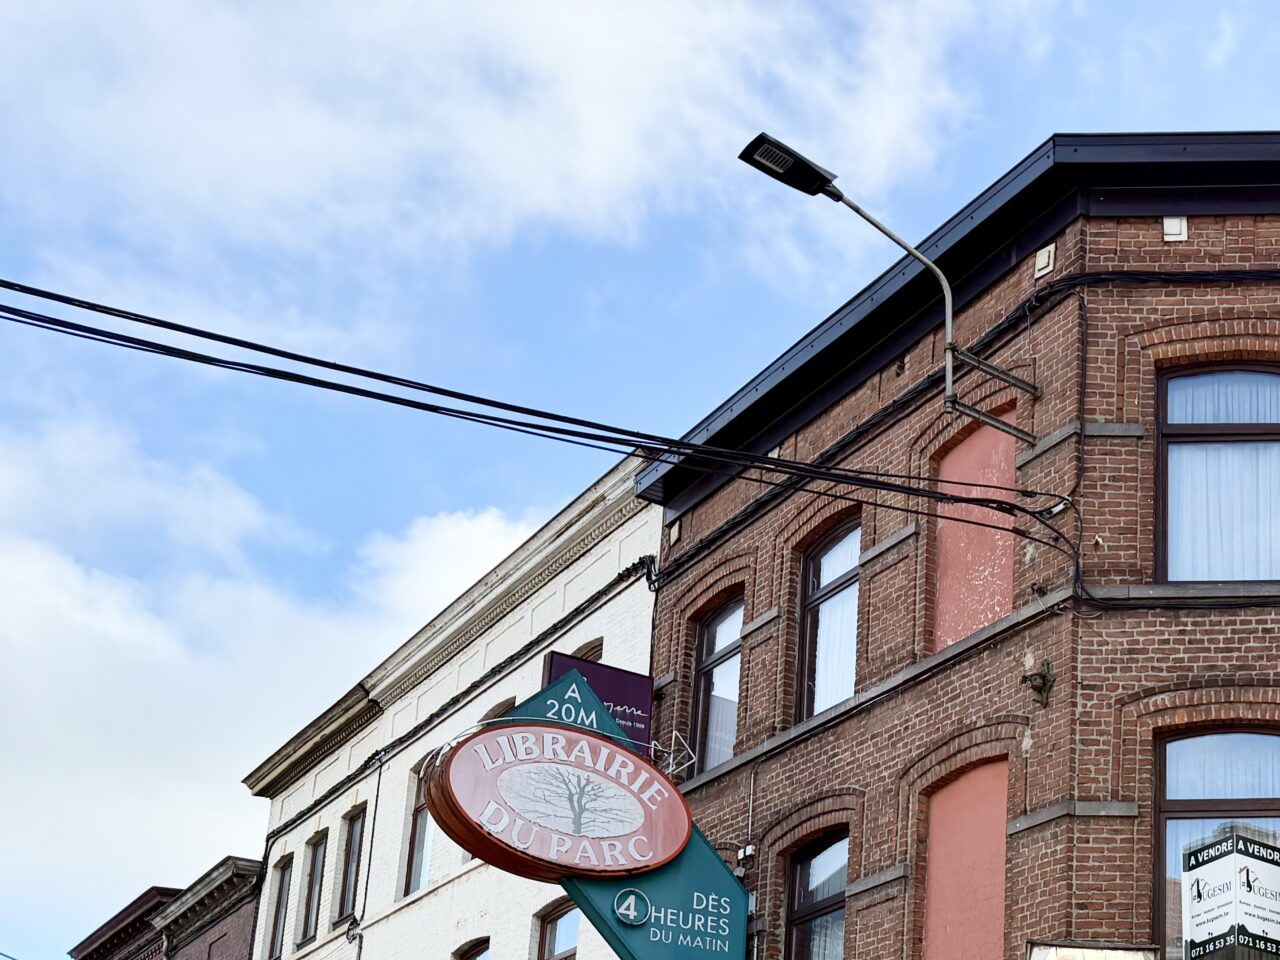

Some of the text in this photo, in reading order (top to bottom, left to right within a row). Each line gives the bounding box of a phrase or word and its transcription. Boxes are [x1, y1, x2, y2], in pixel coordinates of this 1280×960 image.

[564, 682, 582, 703] A
[545, 699, 598, 729] 20M
[473, 732, 670, 811] LIBRAIRIE
[478, 799, 655, 867] DU PARC
[1237, 840, 1245, 851] A
[1189, 839, 1233, 867] A VENDRE
[617, 894, 730, 936] 4 HEURES
[692, 891, 731, 915] DÈS
[649, 927, 729, 953] DU MATIN
[1191, 934, 1235, 958] 071 16 53 35
[1238, 935, 1254, 947] 071
[1255, 939, 1266, 950] 16
[1266, 942, 1277, 953] 53
